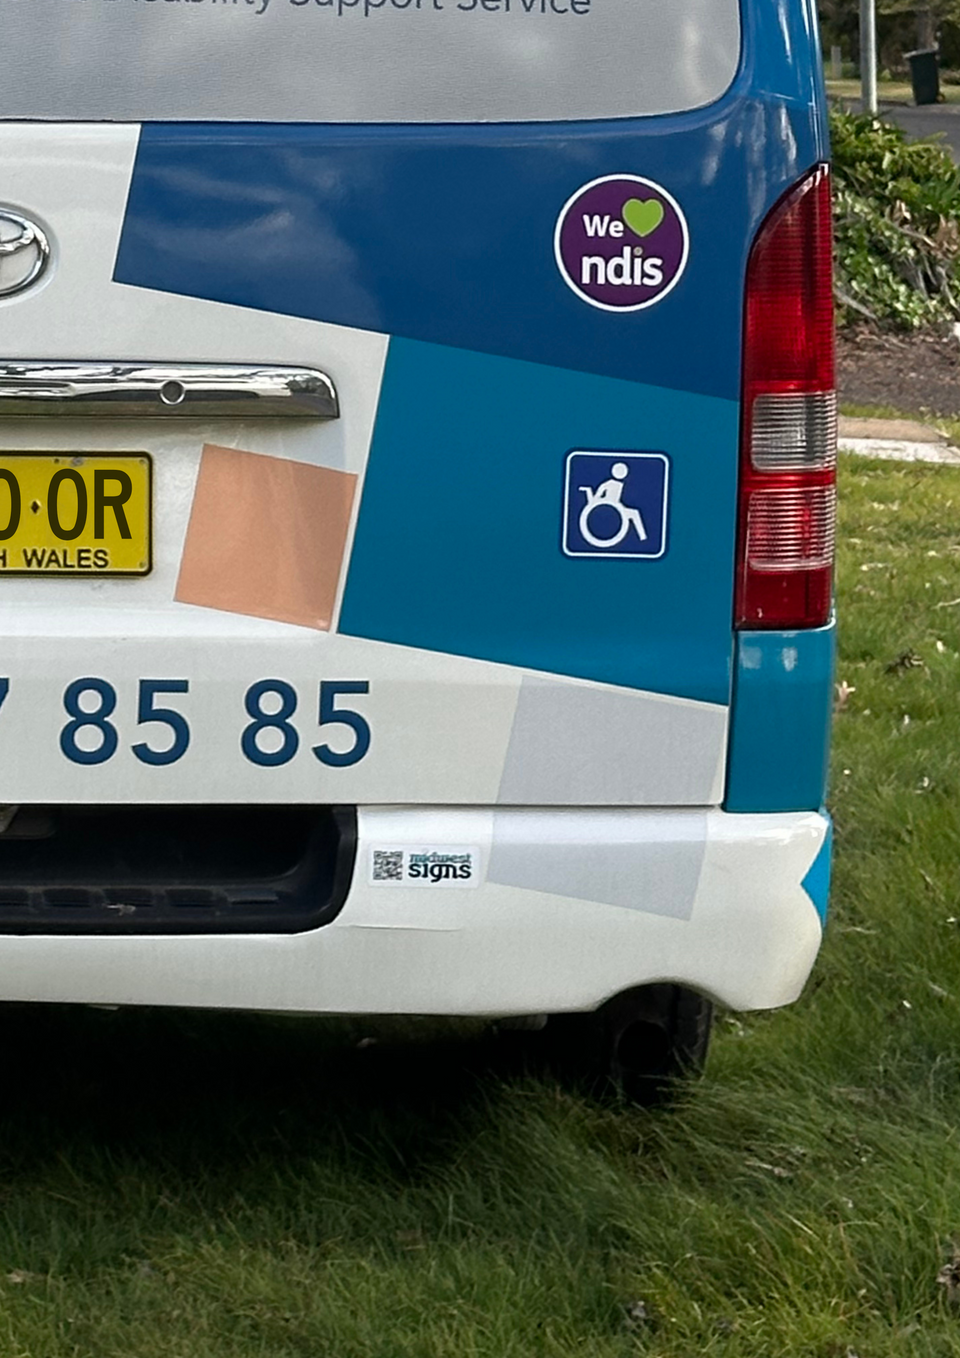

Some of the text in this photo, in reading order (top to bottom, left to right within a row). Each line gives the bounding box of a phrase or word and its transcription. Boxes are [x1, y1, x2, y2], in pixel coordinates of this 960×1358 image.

[583, 214, 625, 238] We
[581, 245, 664, 287] ndis
[23, 549, 110, 568] WALES
[59, 677, 191, 766] 85
[241, 678, 372, 768] 85
[408, 863, 472, 883] signs
